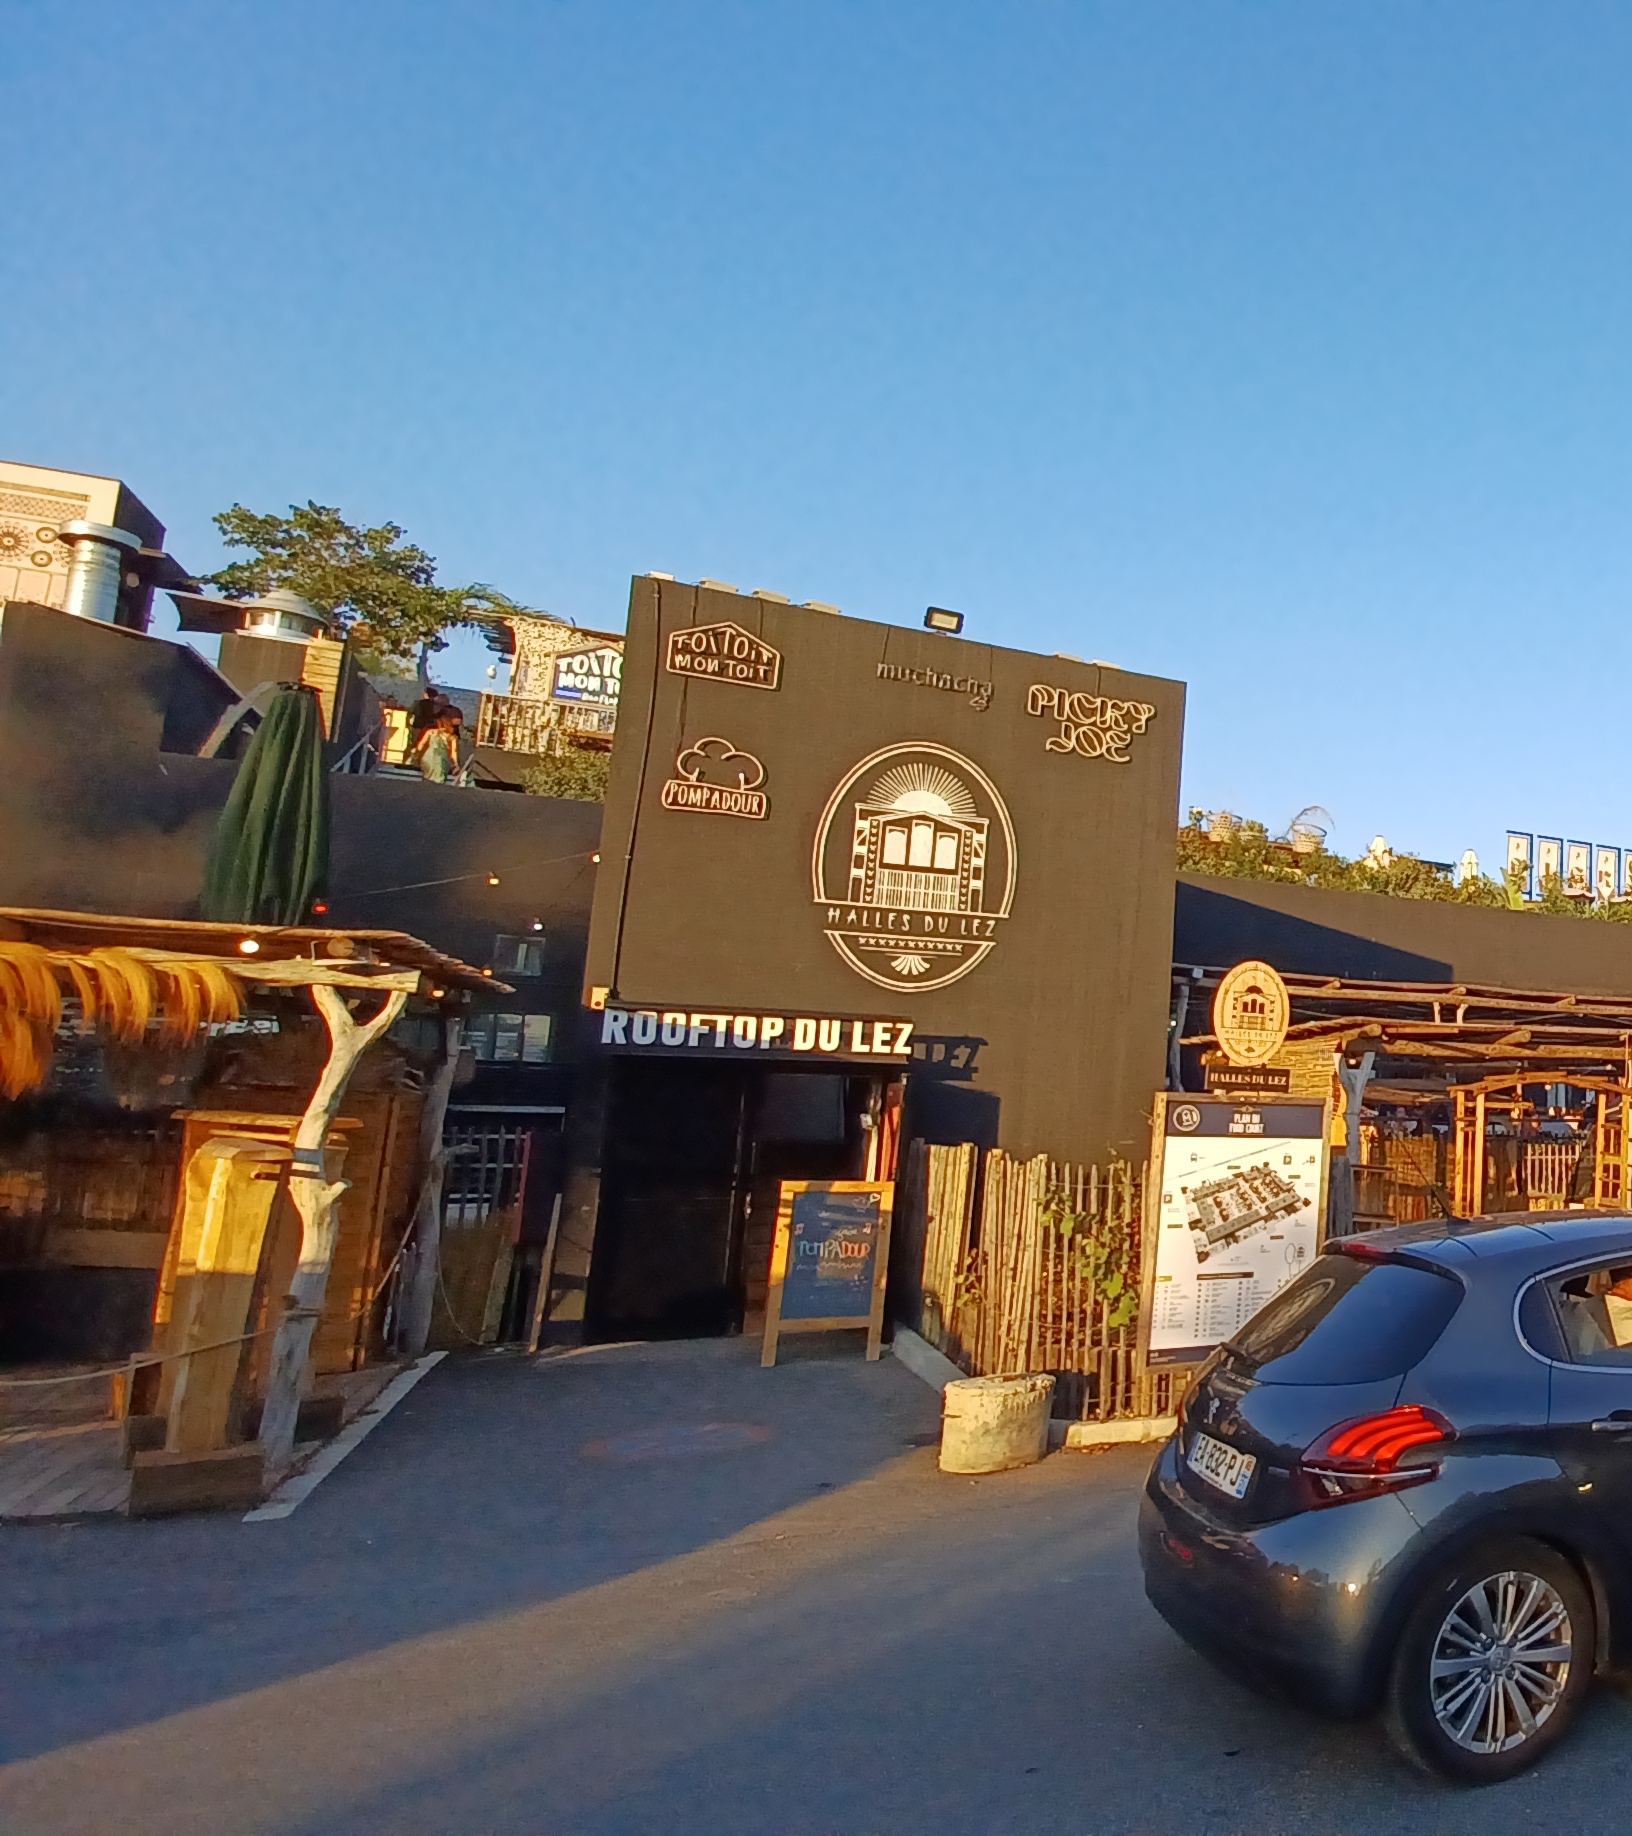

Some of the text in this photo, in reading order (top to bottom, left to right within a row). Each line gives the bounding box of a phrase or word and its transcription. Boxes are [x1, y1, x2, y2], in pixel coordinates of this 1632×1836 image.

[675, 654, 719, 673] MON
[876, 661, 993, 697] muchacha
[558, 672, 601, 691] MON
[1027, 684, 1155, 733] PICKY
[1046, 722, 1131, 763] JOE
[667, 782, 760, 814] POMPADOUR
[827, 907, 996, 937] HALLES DU LEZ
[601, 1008, 914, 1055] ROOFTOP DU LEZ
[1210, 1072, 1287, 1086] HALLES DU LEZ
